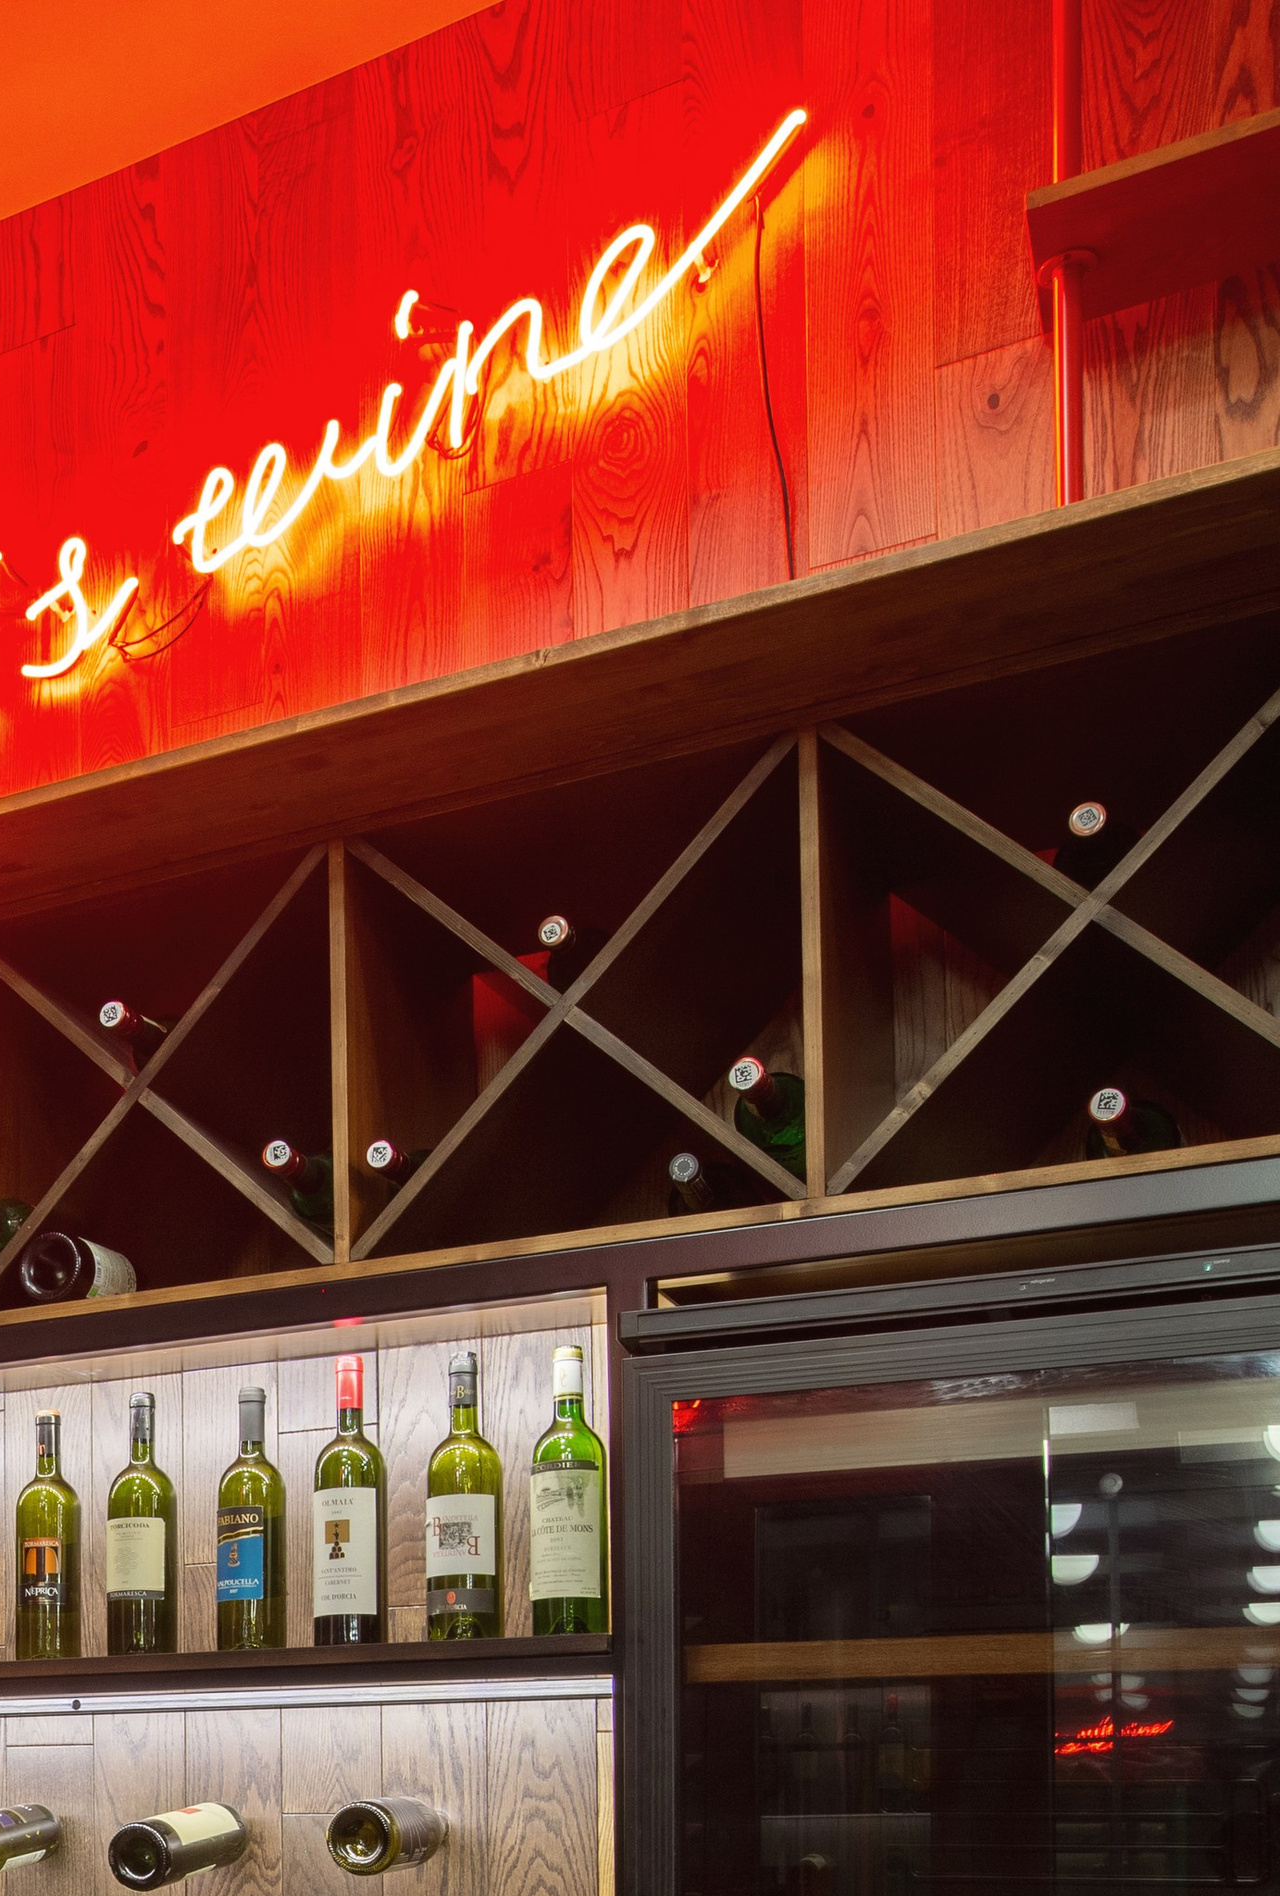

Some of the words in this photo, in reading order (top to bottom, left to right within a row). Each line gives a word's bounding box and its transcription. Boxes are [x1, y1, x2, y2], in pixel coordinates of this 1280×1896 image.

[172, 107, 808, 574] wine
[556, 1525, 568, 1533] DE
[570, 1524, 594, 1533] MONS
